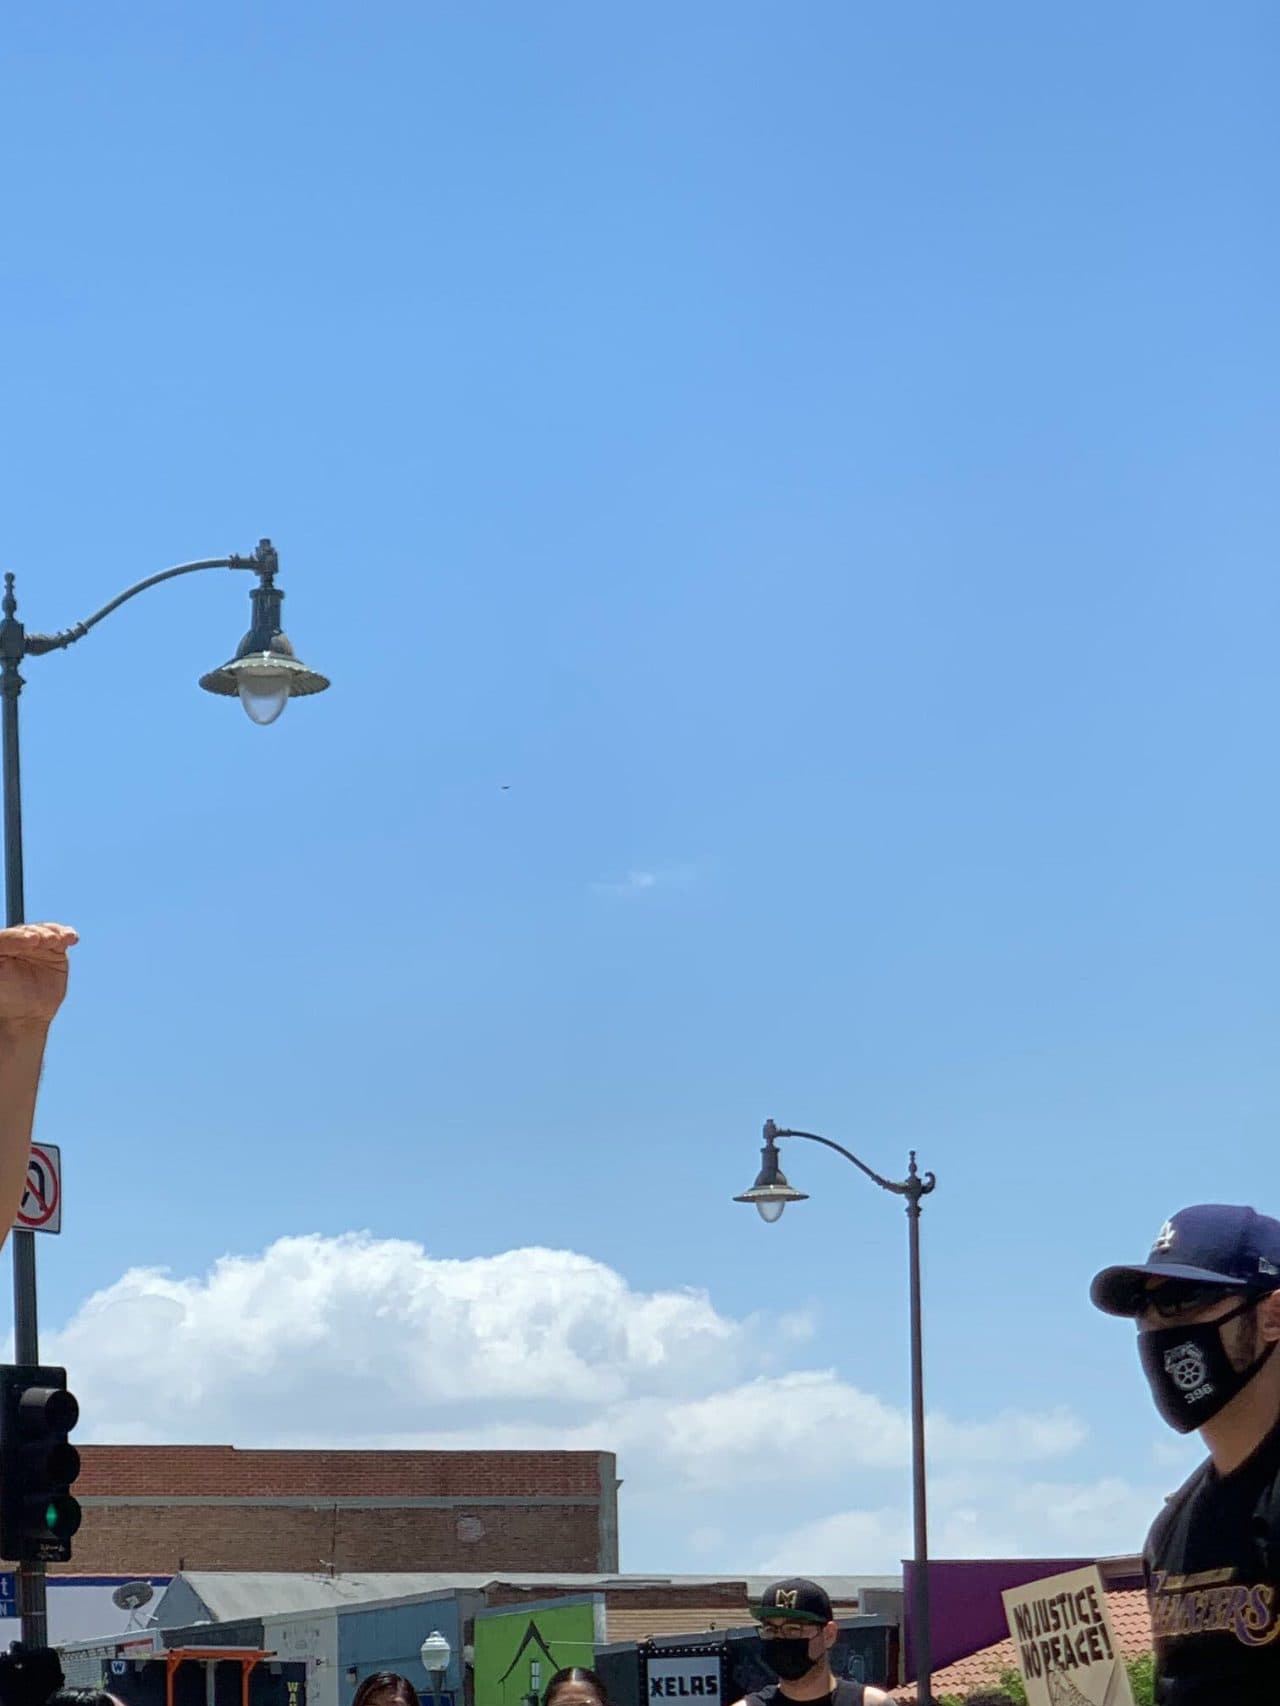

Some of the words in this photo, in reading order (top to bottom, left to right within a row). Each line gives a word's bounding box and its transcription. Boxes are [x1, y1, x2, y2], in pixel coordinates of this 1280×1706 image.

[0, 1603, 8, 1616] N
[1032, 1585, 1103, 1636] JUSTICE
[1020, 1641, 1042, 1680] NO
[1039, 1622, 1114, 1672] PEACE!
[650, 1675, 718, 1698] XELAS
